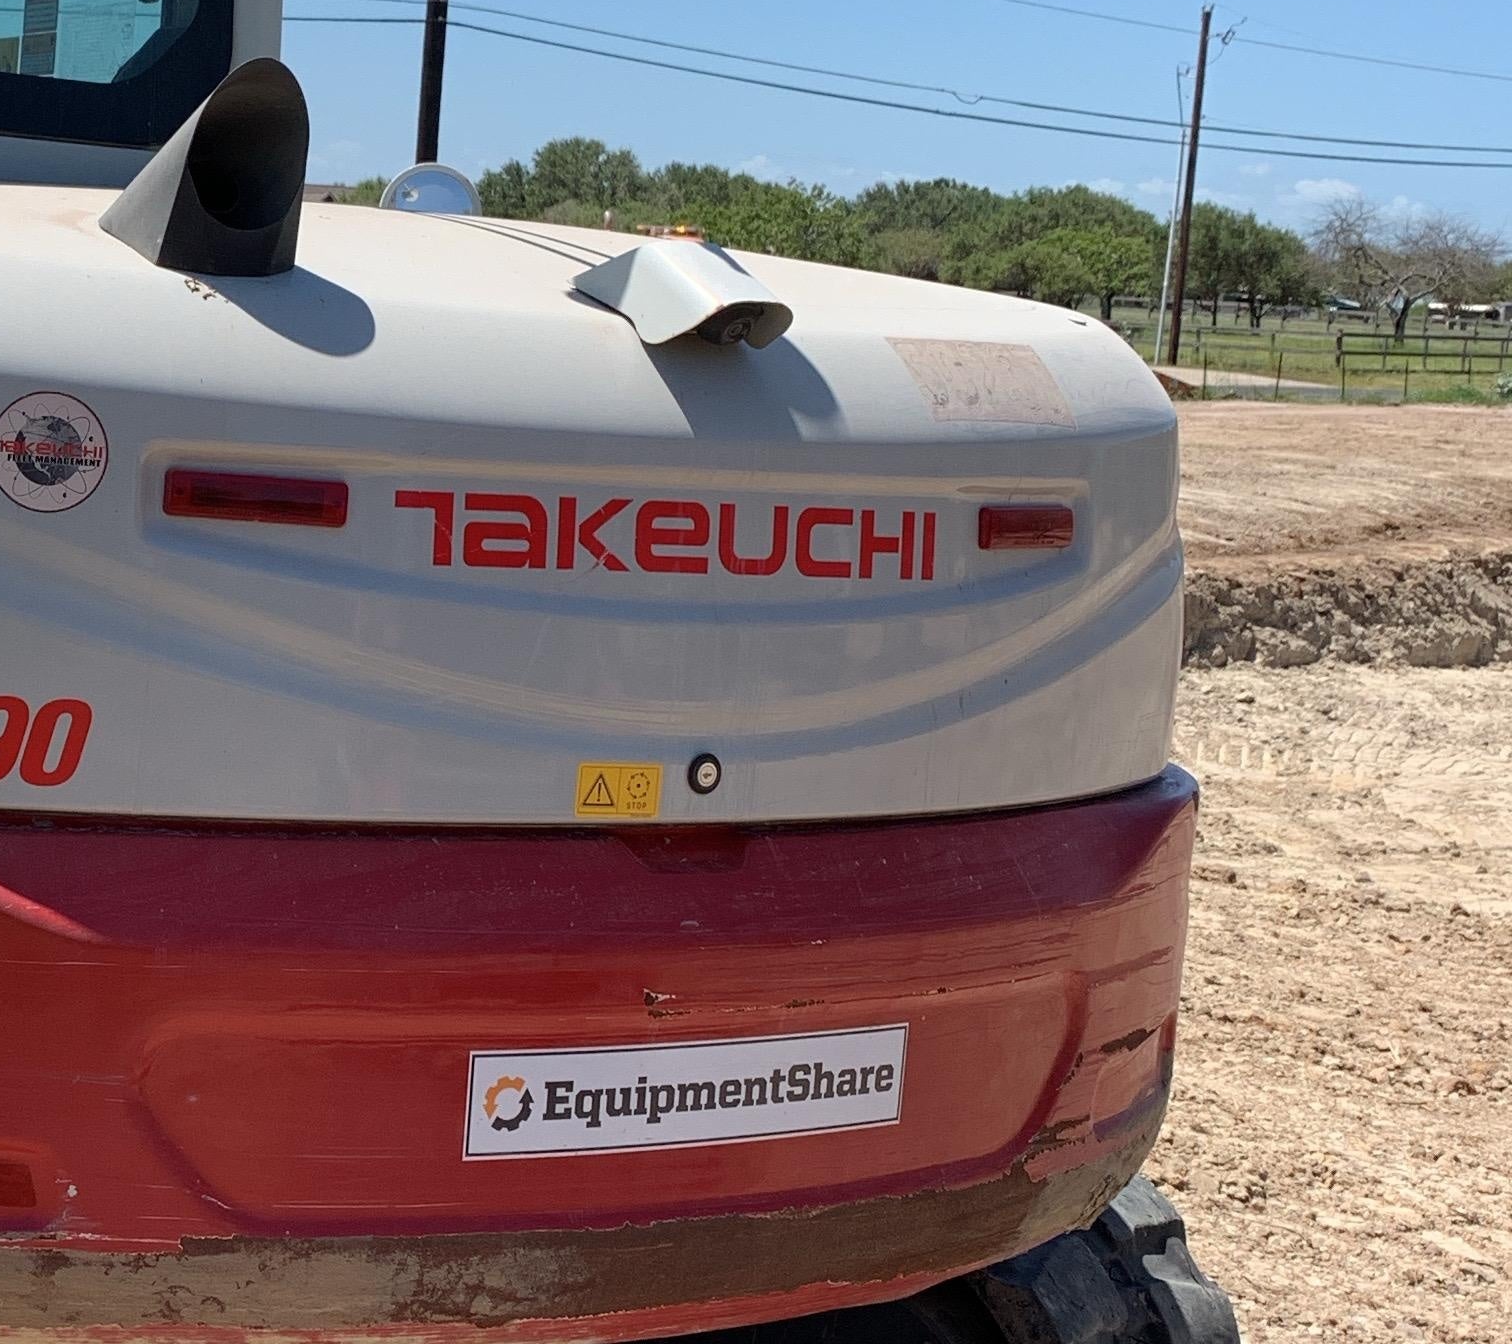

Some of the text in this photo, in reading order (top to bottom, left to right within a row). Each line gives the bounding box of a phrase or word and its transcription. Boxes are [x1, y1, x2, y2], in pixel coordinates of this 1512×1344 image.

[35, 456, 102, 468] MANAGEMENT
[626, 801, 647, 810] STOP
[542, 1062, 895, 1128] EquipmentShare
